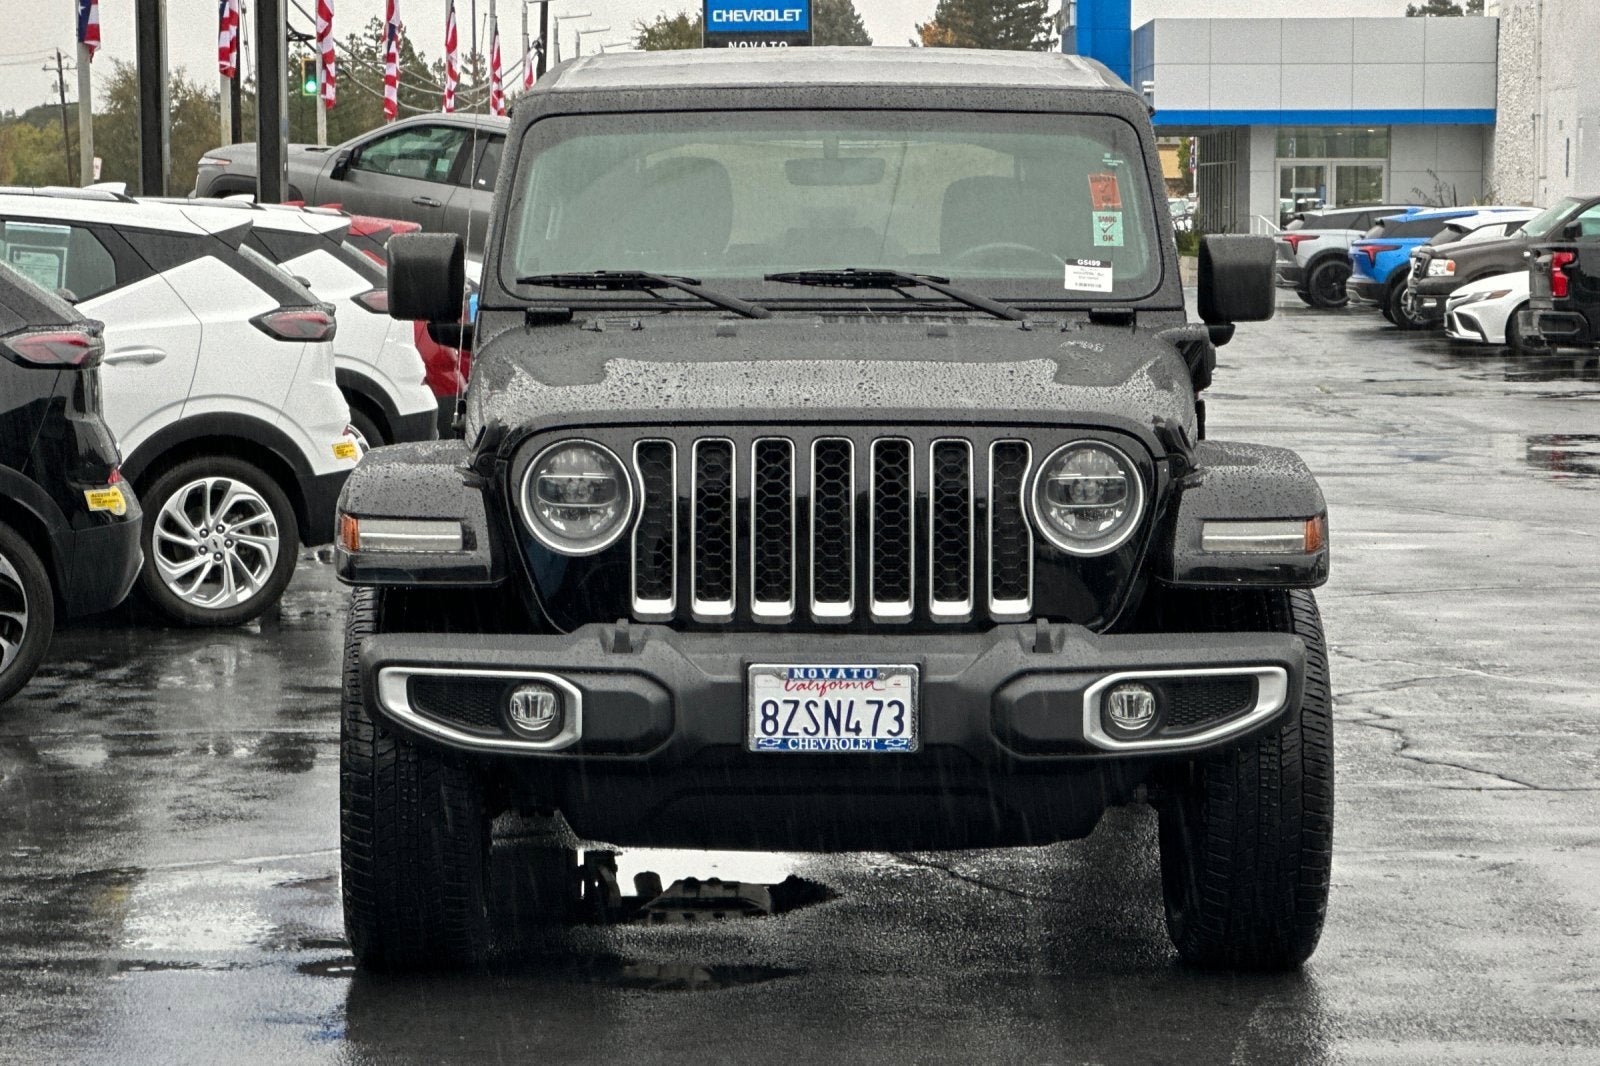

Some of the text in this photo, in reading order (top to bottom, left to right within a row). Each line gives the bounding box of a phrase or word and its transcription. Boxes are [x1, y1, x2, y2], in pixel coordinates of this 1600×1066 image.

[713, 9, 802, 22] CHEVROLET
[793, 668, 874, 679] NOVATO
[784, 679, 885, 697] California
[761, 699, 905, 737] 8ZSN473
[787, 738, 879, 750] CHEVROLET
